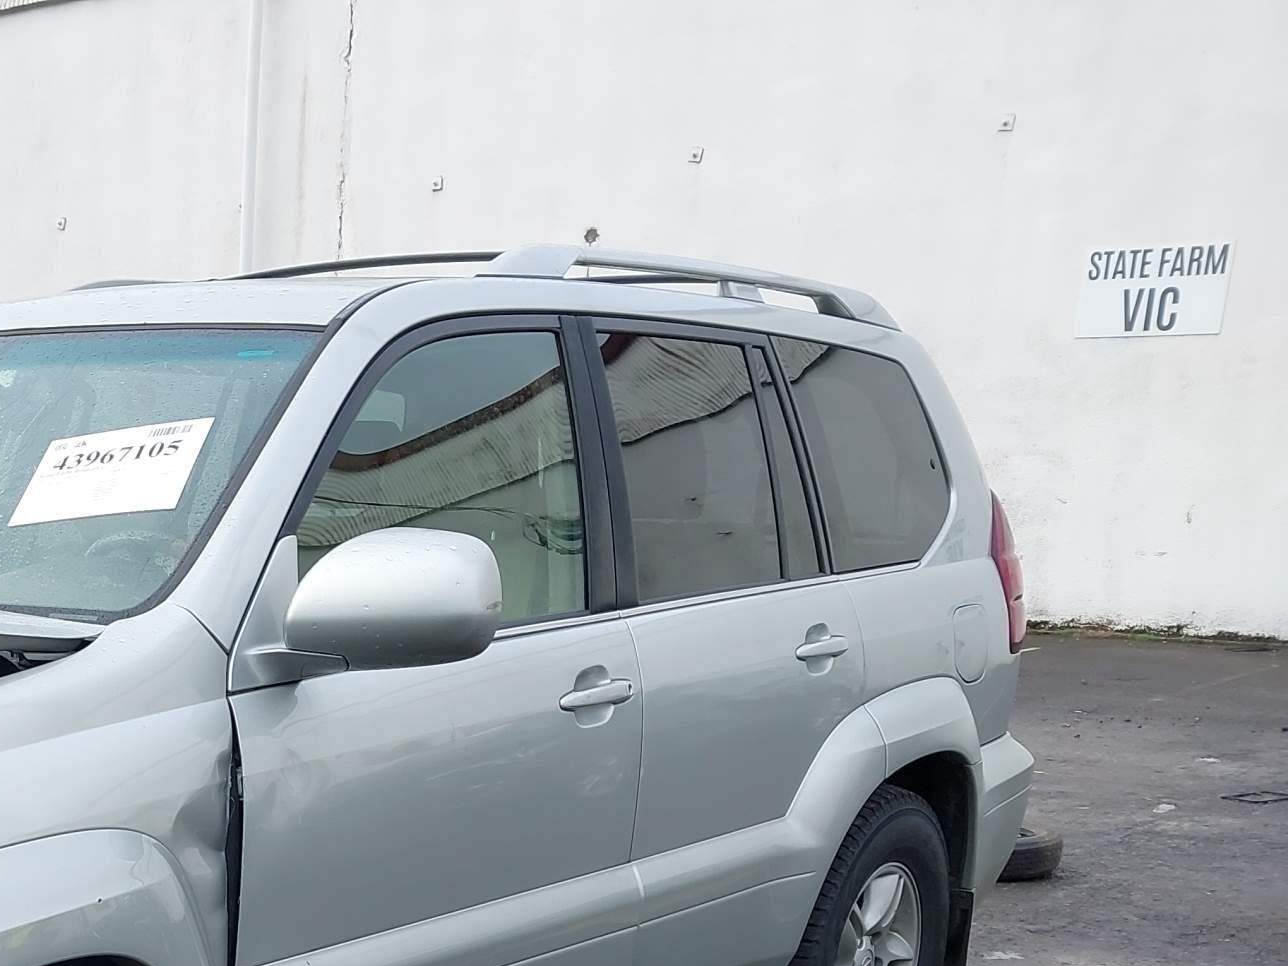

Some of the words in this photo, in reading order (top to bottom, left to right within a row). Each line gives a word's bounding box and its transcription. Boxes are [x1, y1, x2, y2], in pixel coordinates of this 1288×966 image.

[1088, 249, 1154, 280] STATE
[1158, 244, 1230, 277] FARM
[1123, 286, 1180, 332] VIC
[52, 439, 184, 470] 43967105
